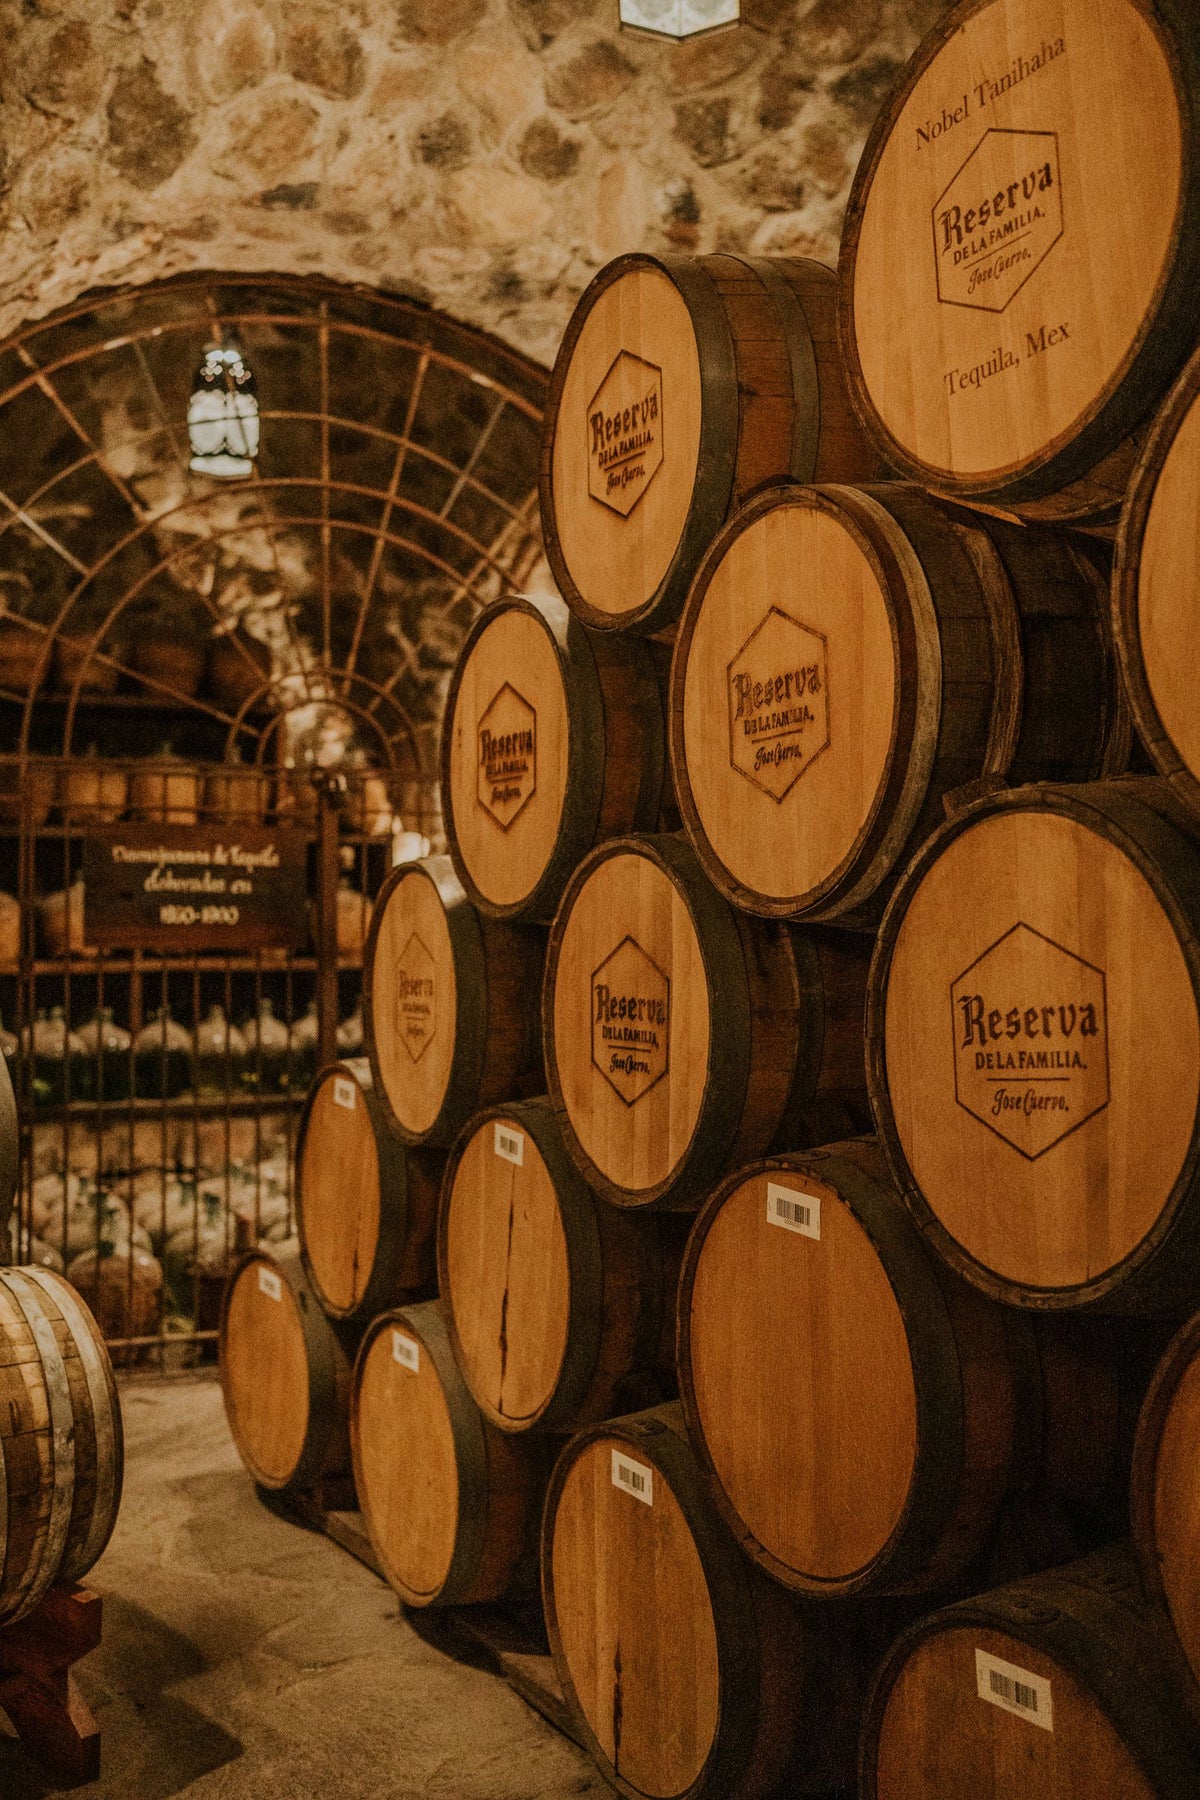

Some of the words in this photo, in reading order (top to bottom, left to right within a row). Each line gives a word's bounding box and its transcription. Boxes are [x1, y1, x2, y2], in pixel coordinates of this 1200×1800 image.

[915, 94, 970, 151] Nobel
[973, 37, 1067, 109] Tanihaha
[937, 162, 1053, 256] Reserva
[943, 347, 1020, 395] Tequila,
[1026, 322, 1071, 358] Mex
[590, 393, 659, 456] Reserva
[732, 664, 822, 721] Reserva
[480, 728, 533, 766] Reserva
[595, 984, 667, 1025] Reserva
[957, 994, 1098, 1050] Reserva
